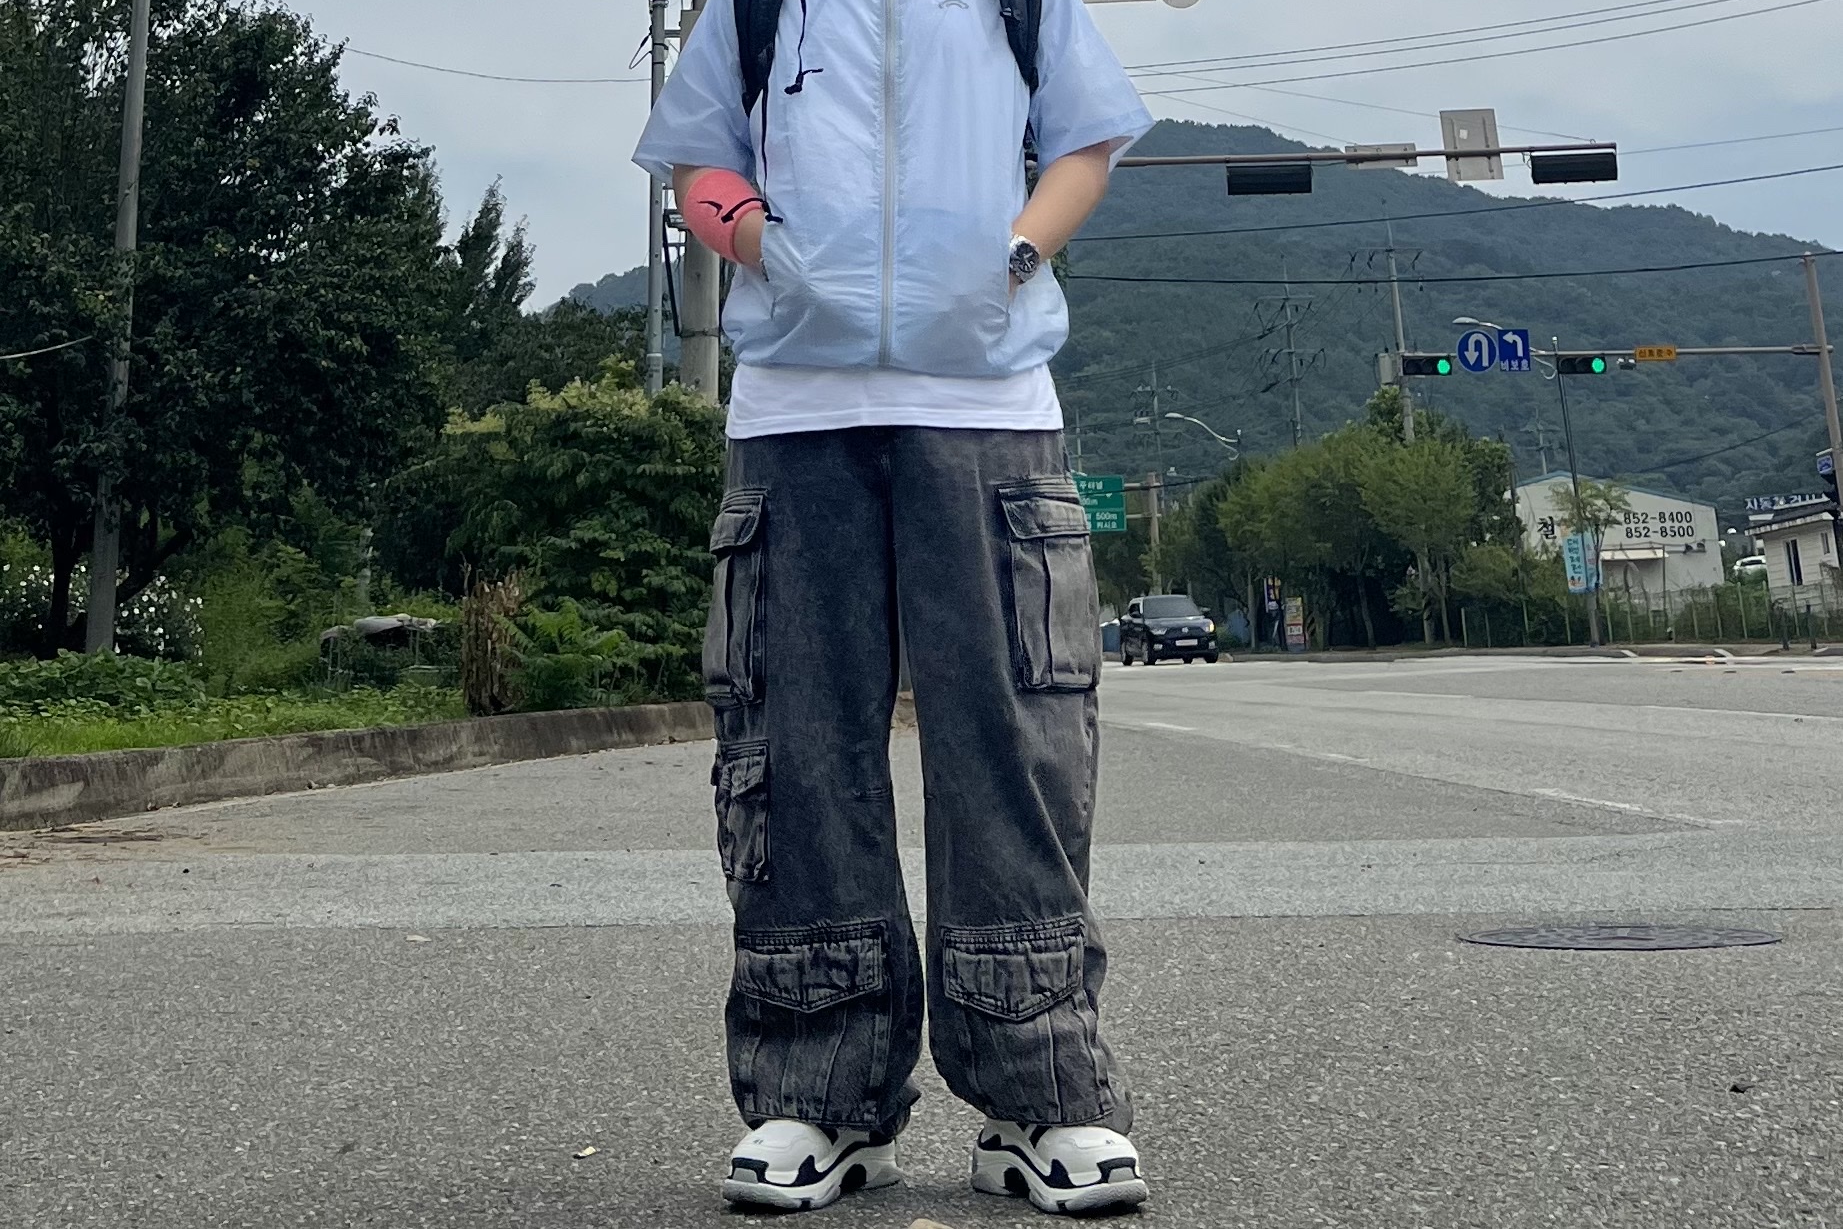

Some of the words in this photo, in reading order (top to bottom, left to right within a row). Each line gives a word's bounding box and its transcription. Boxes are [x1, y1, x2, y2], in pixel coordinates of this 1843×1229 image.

[1500, 358, 1530, 372] 비보호
[1623, 511, 1693, 525] 852-8400
[1537, 516, 1557, 540] 철
[1625, 525, 1695, 539] 852-8500
